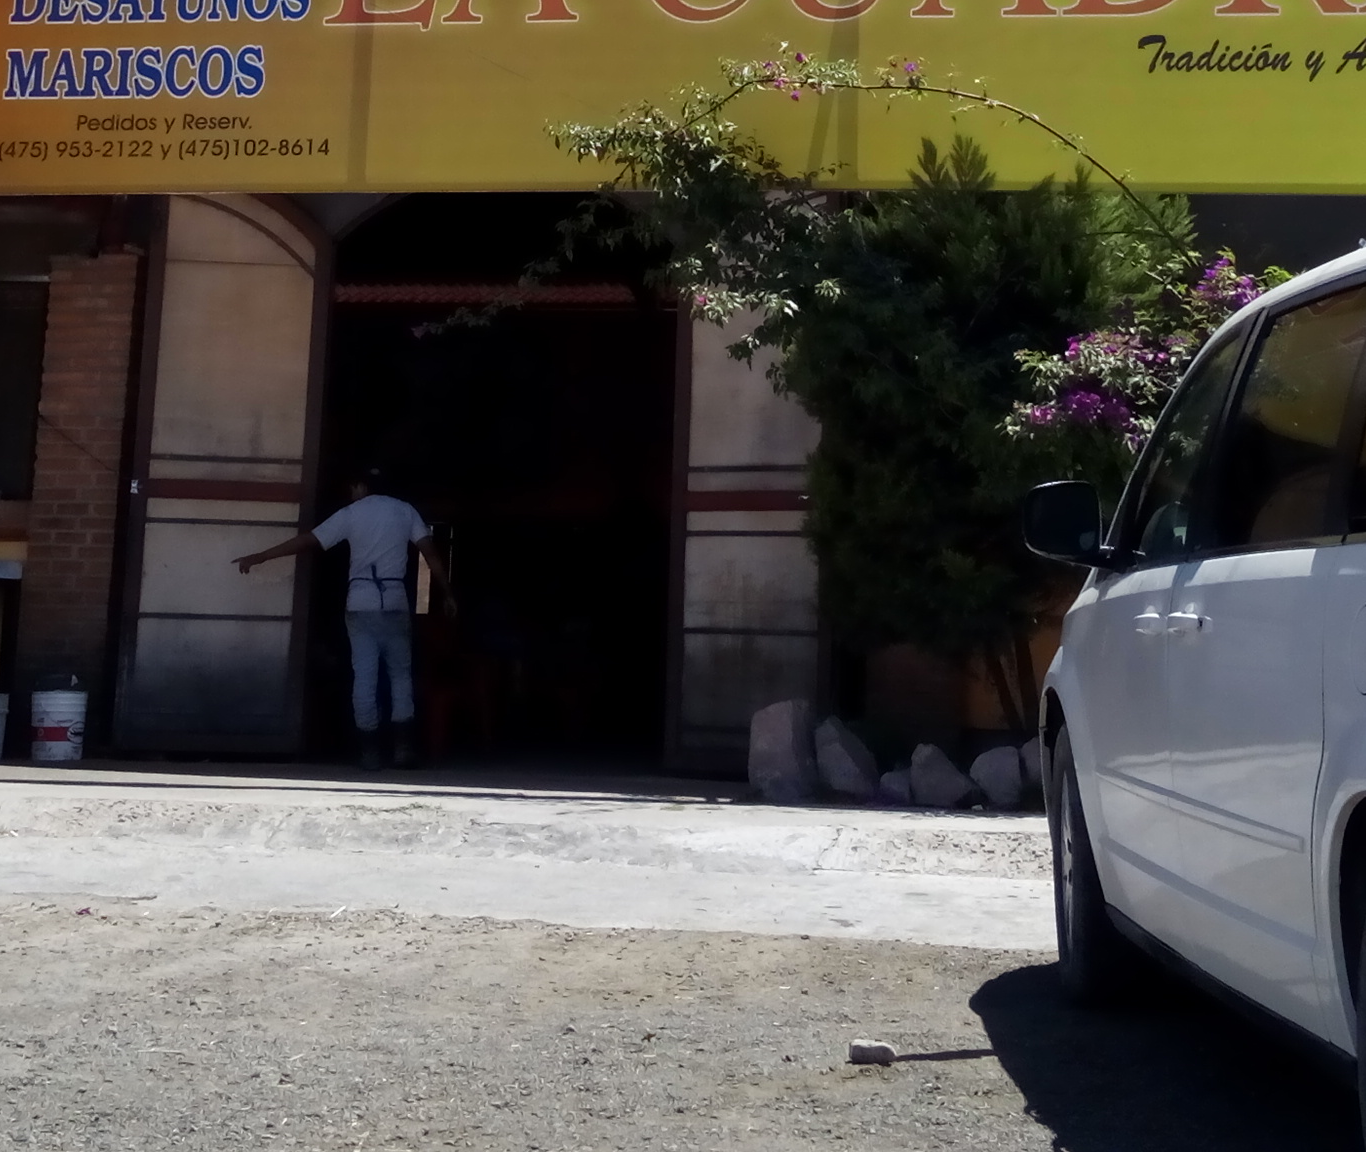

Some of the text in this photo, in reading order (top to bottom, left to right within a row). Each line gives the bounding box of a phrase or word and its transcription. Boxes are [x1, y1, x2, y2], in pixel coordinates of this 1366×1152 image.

[2, 44, 266, 101] MARISCOS
[1137, 34, 1292, 75] Tradición
[1304, 48, 1326, 83] y
[76, 113, 253, 134] Pedidos y Reserv.
[56, 140, 153, 159] 953-2122
[161, 143, 172, 161] y
